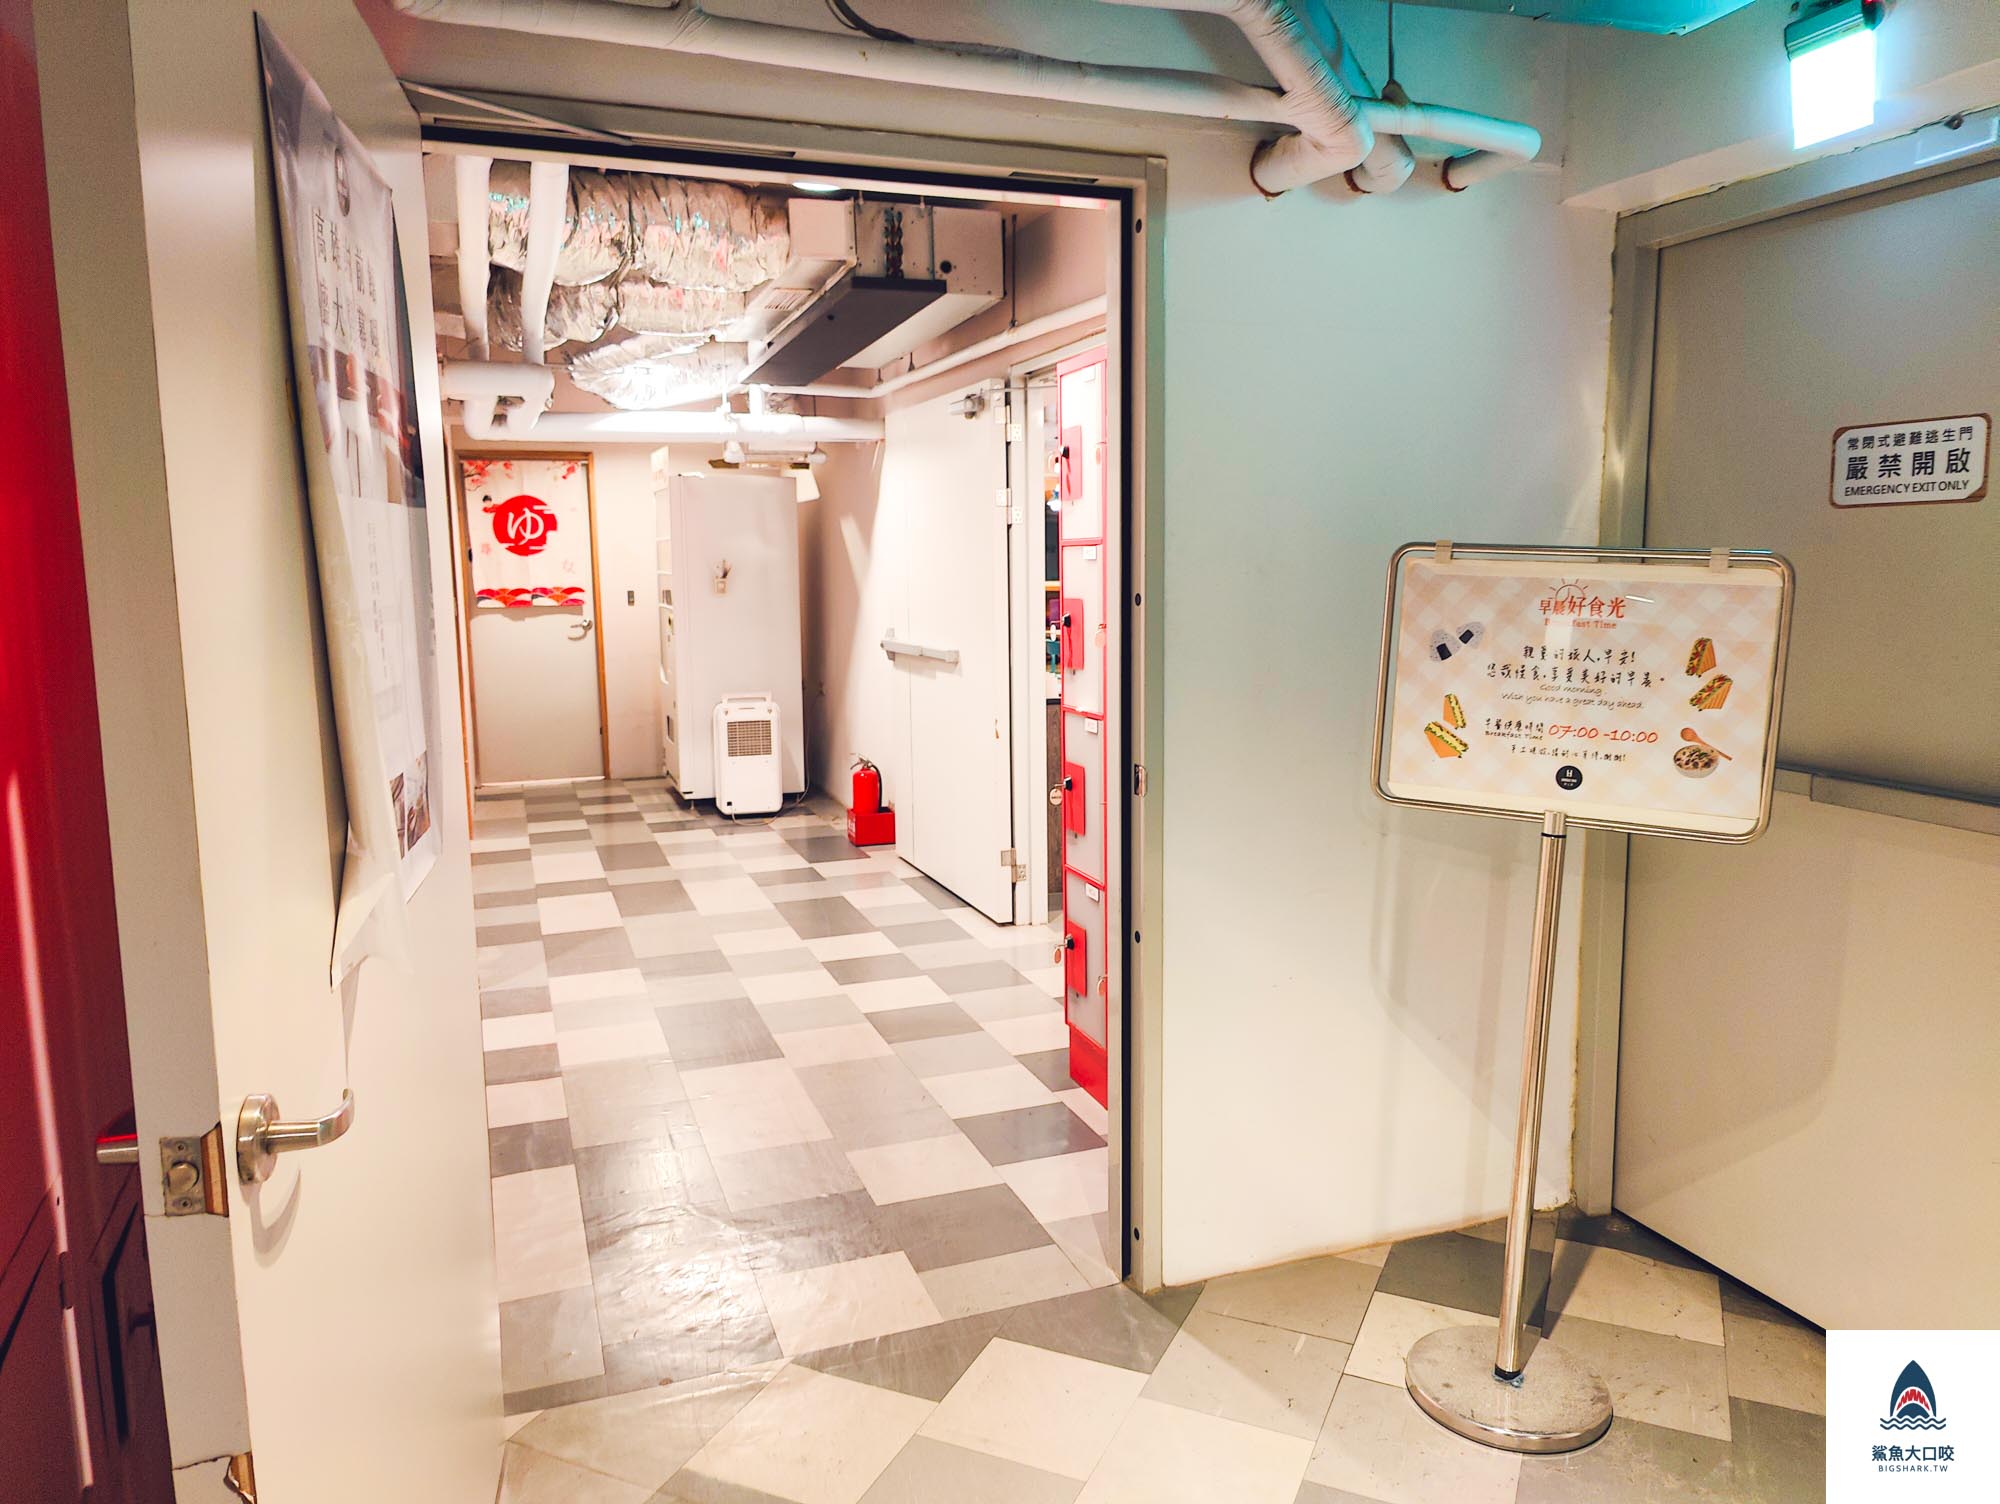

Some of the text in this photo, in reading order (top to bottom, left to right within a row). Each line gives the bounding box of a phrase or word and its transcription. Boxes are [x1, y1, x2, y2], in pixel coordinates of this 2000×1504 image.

[1847, 426, 1973, 450] 常閉式避難逃生門
[1845, 447, 1971, 481] 嚴禁開啟
[1844, 480, 1970, 496] EMERGENCY EXIT ONLY
[506, 507, 544, 545] ゆ
